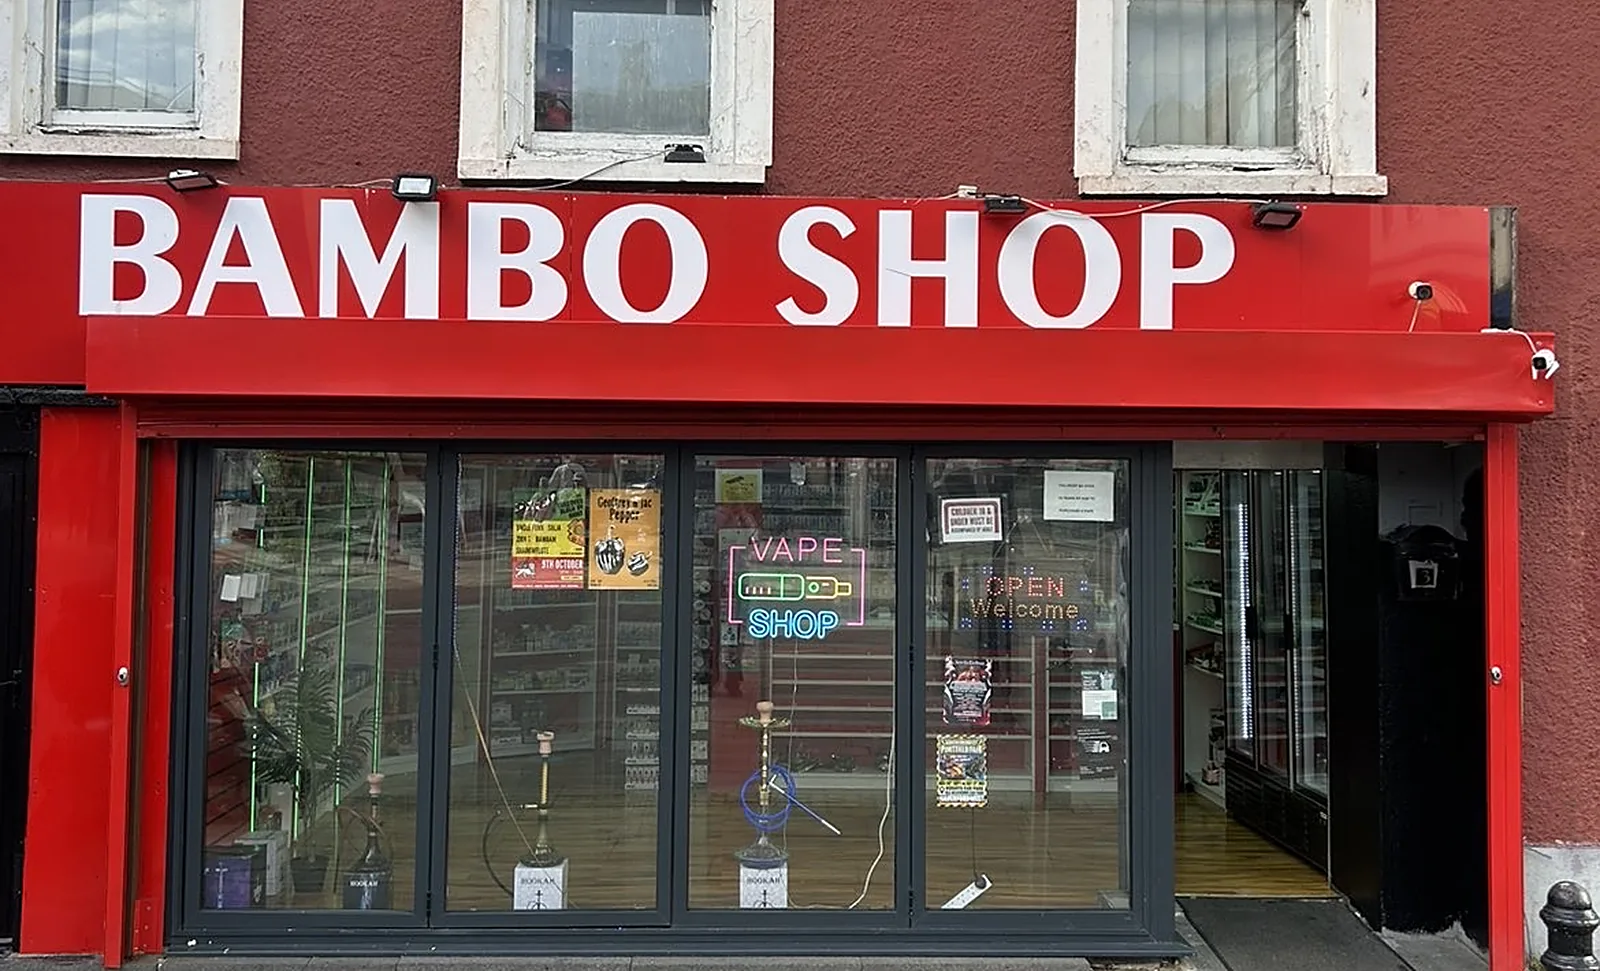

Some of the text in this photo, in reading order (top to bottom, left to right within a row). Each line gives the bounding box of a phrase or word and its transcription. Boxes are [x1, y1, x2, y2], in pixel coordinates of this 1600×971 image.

[79, 193, 1236, 330] BAMBO SHOP
[610, 508, 640, 524] Pepper
[751, 536, 843, 563] VAPE
[555, 559, 584, 569] OCTOBER
[986, 576, 1064, 597] OPEN
[1420, 569, 1431, 584] 3
[970, 598, 1079, 619] Welcome
[748, 609, 838, 639] SHOP
